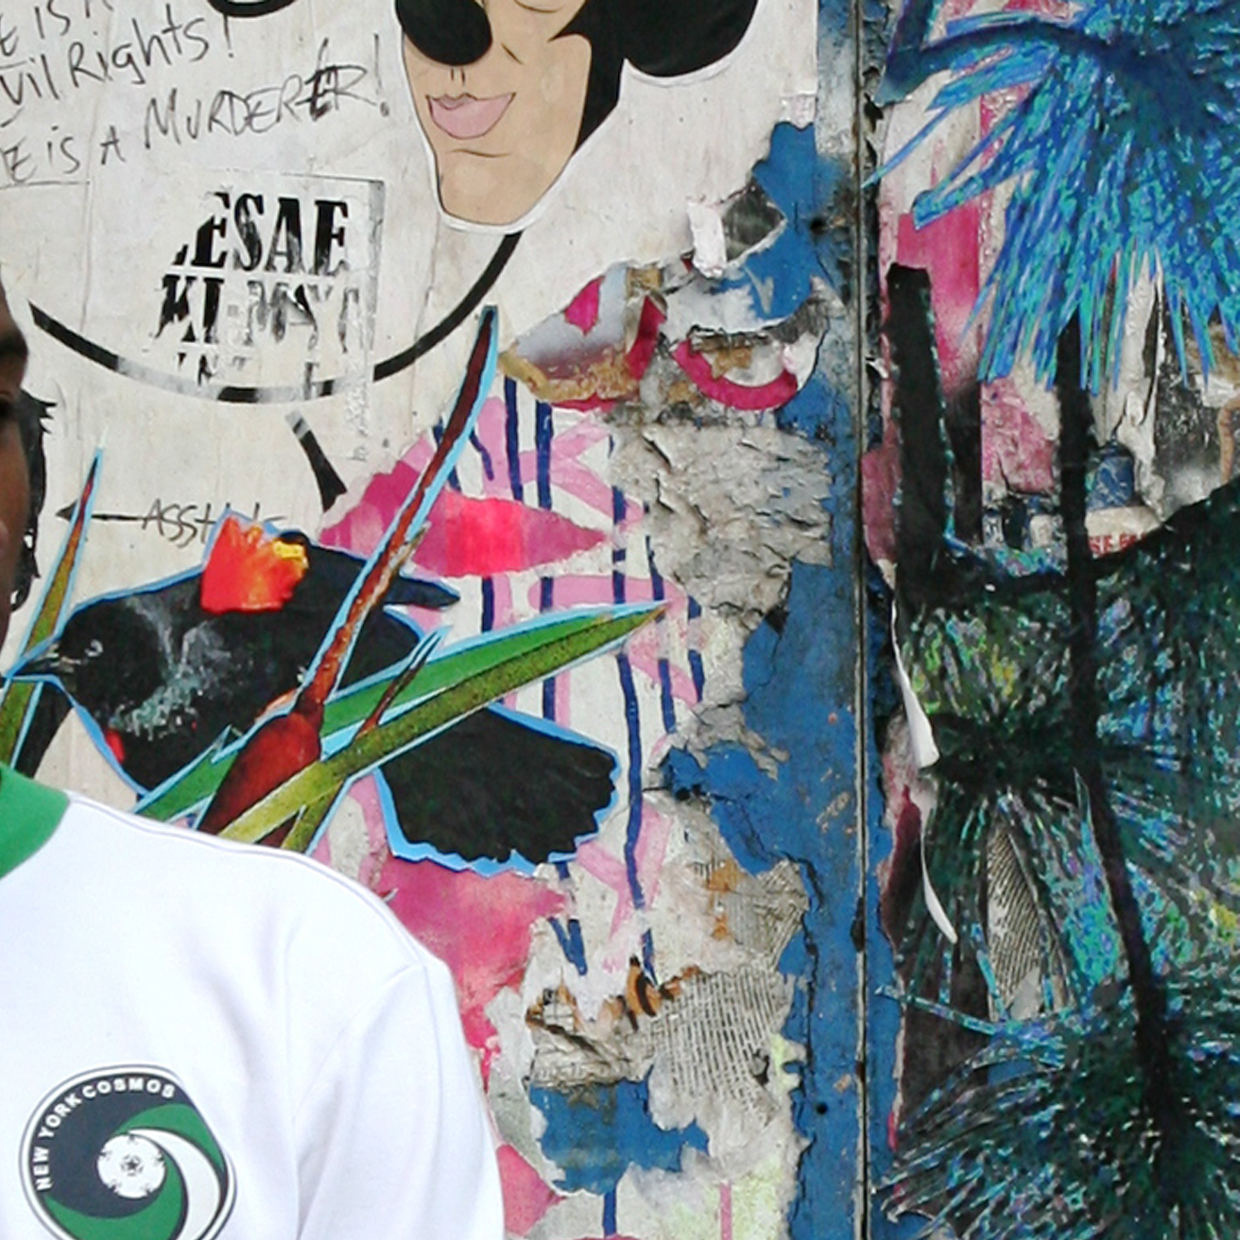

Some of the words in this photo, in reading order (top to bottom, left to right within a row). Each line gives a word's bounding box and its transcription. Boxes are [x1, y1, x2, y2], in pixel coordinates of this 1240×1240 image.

[100, 125, 126, 166] A
[81, 1077, 176, 1101] COSMOS
[37, 1092, 83, 1141] YORK
[32, 1145, 53, 1192] NEW
